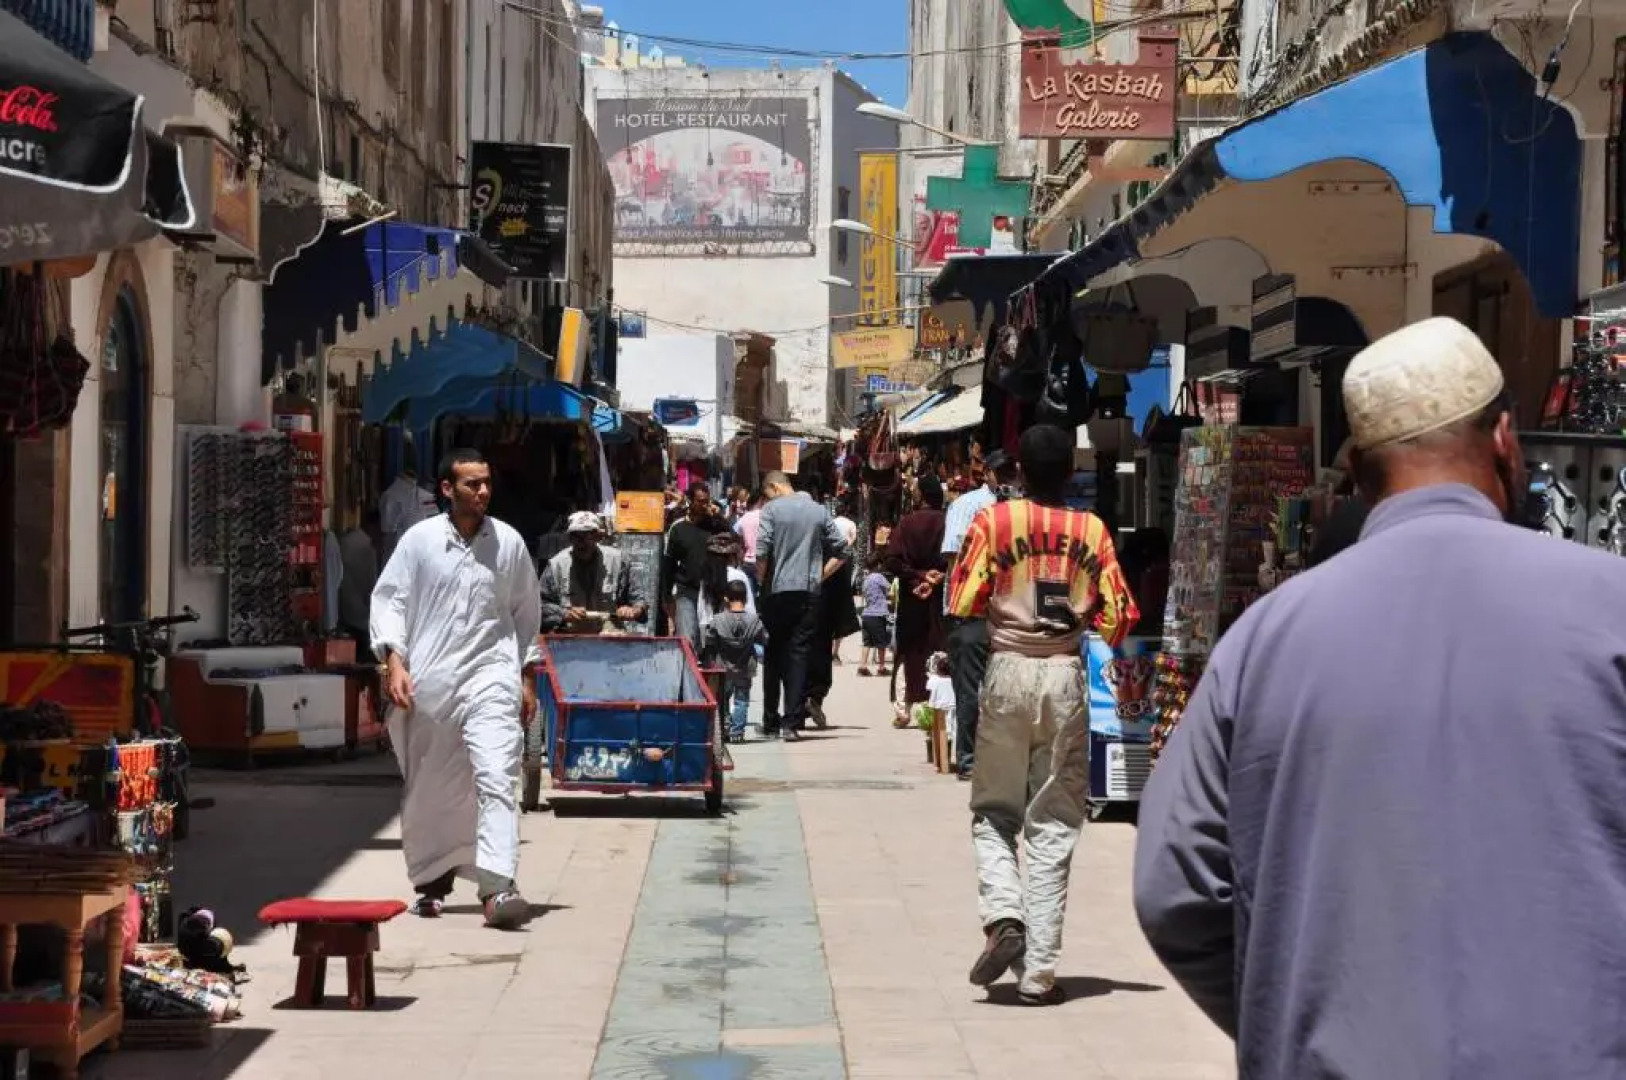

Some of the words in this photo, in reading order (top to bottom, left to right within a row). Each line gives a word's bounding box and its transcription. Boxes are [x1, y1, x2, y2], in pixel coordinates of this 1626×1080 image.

[1026, 75, 1057, 102] La
[614, 113, 789, 128] HOTEL-RESTAURANT
[1056, 99, 1142, 134] Galerie
